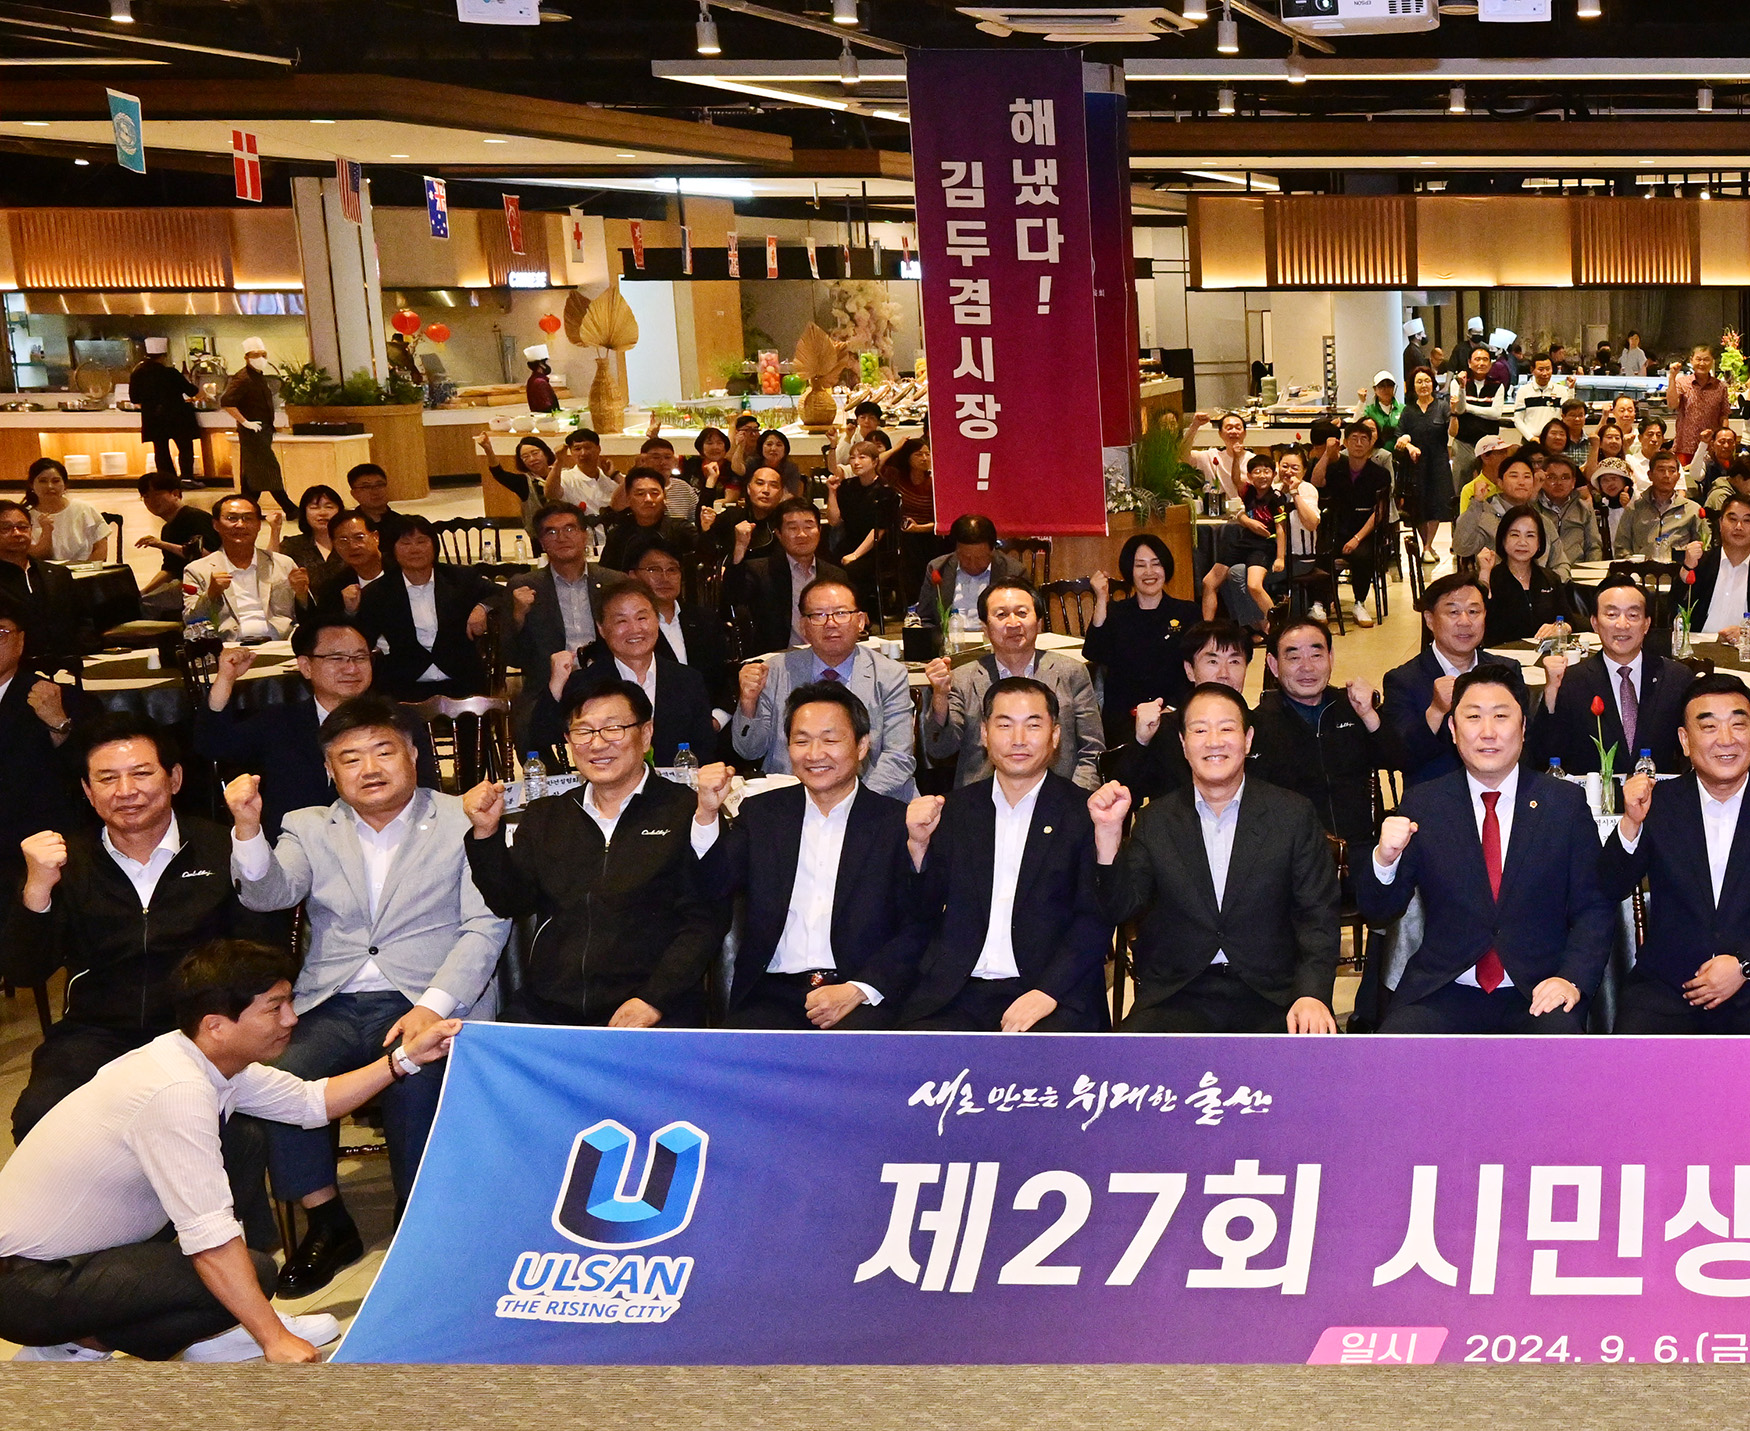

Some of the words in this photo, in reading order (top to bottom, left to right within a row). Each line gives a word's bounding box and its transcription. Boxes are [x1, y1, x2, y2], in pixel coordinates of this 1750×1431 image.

[1009, 97, 1064, 316] 해냈다!
[940, 160, 1001, 491] 김두겸시장!
[907, 1068, 984, 1137] 새로
[988, 1083, 1060, 1112] 만드는
[1065, 1074, 1178, 1132] 위대한
[1184, 1071, 1274, 1126] 울산
[853, 1159, 1322, 1295] 제27회
[503, 1299, 540, 1314] THE
[545, 1301, 618, 1318] RISING
[624, 1304, 673, 1319] CITY
[513, 1256, 691, 1297] ULSAN
[1339, 1332, 1418, 1365] 일시
[1463, 1334, 1582, 1363] 2024.
[1600, 1335, 1636, 1364] 9.
